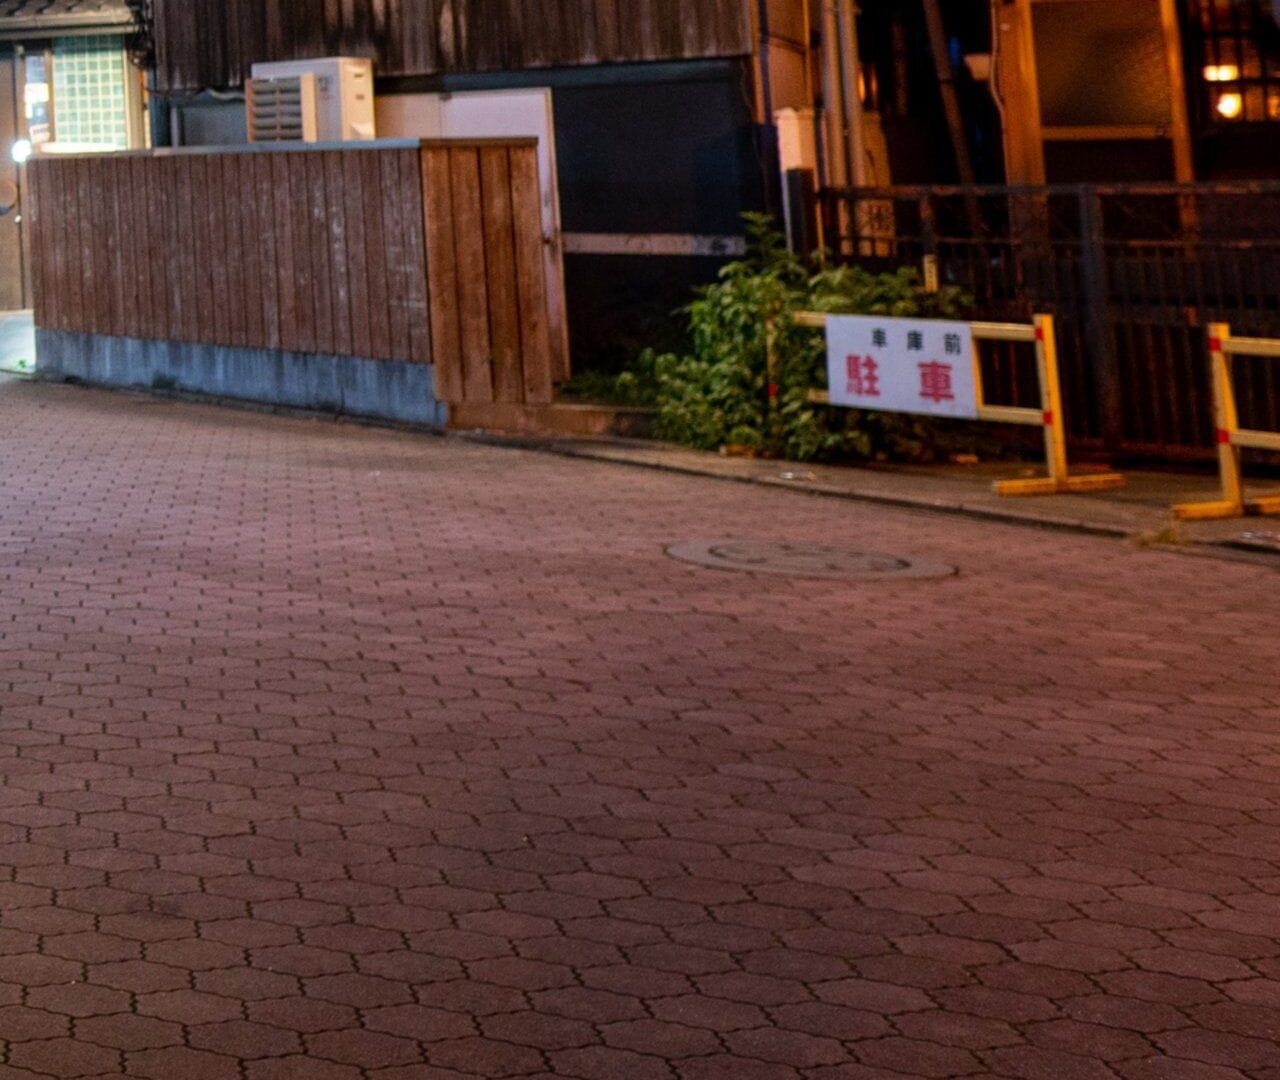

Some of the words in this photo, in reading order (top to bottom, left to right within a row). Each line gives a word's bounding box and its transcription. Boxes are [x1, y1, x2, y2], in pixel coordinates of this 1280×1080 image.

[872, 328, 962, 355] 車庫前
[845, 354, 956, 403] 駐車
